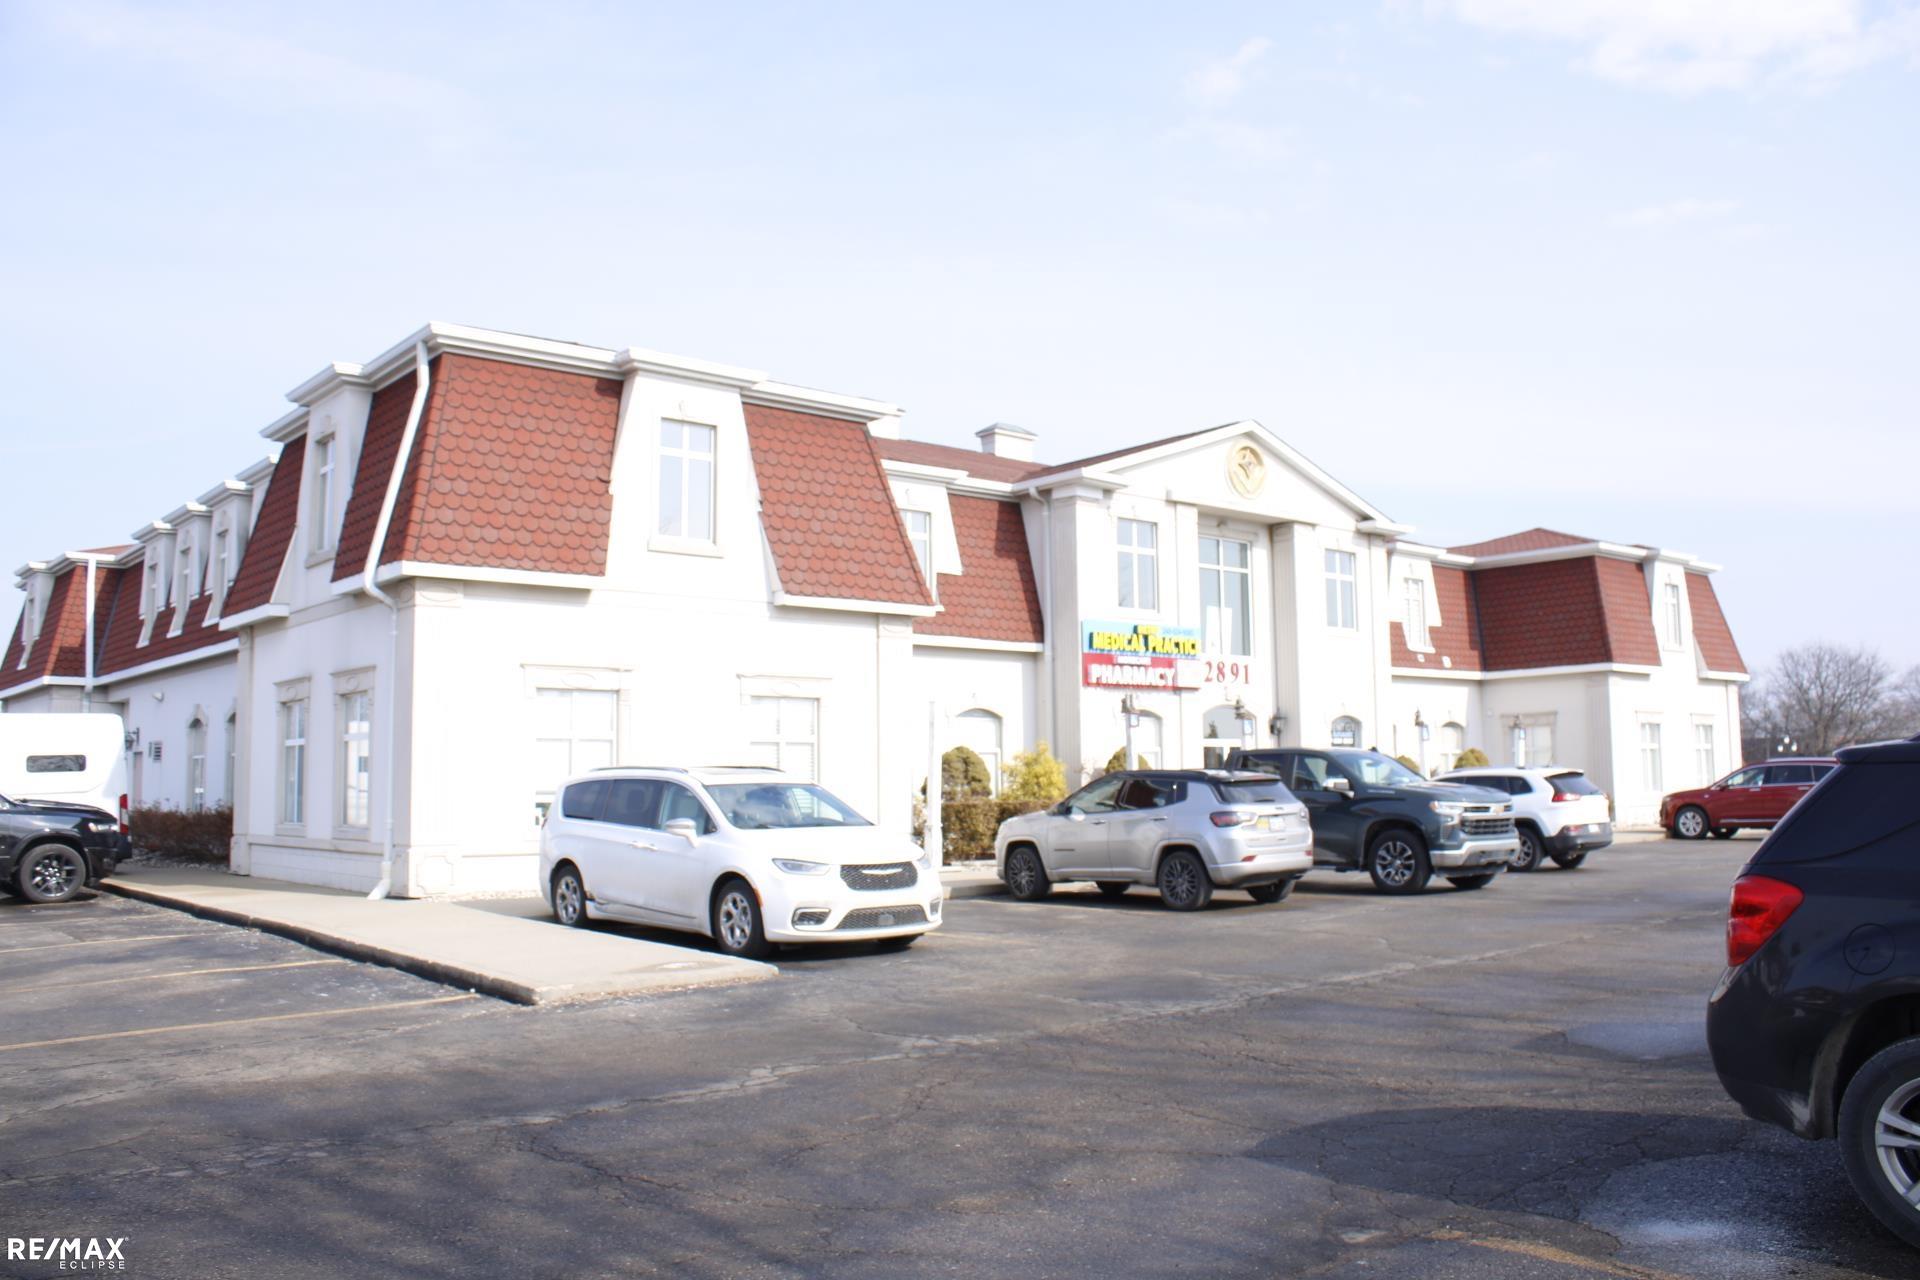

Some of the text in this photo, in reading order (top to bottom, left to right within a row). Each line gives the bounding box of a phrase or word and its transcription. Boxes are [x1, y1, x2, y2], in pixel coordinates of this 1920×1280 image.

[1091, 631, 1145, 652] MEDICAL
[1090, 664, 1176, 686] PHARMACY
[1204, 661, 1250, 684] 2891
